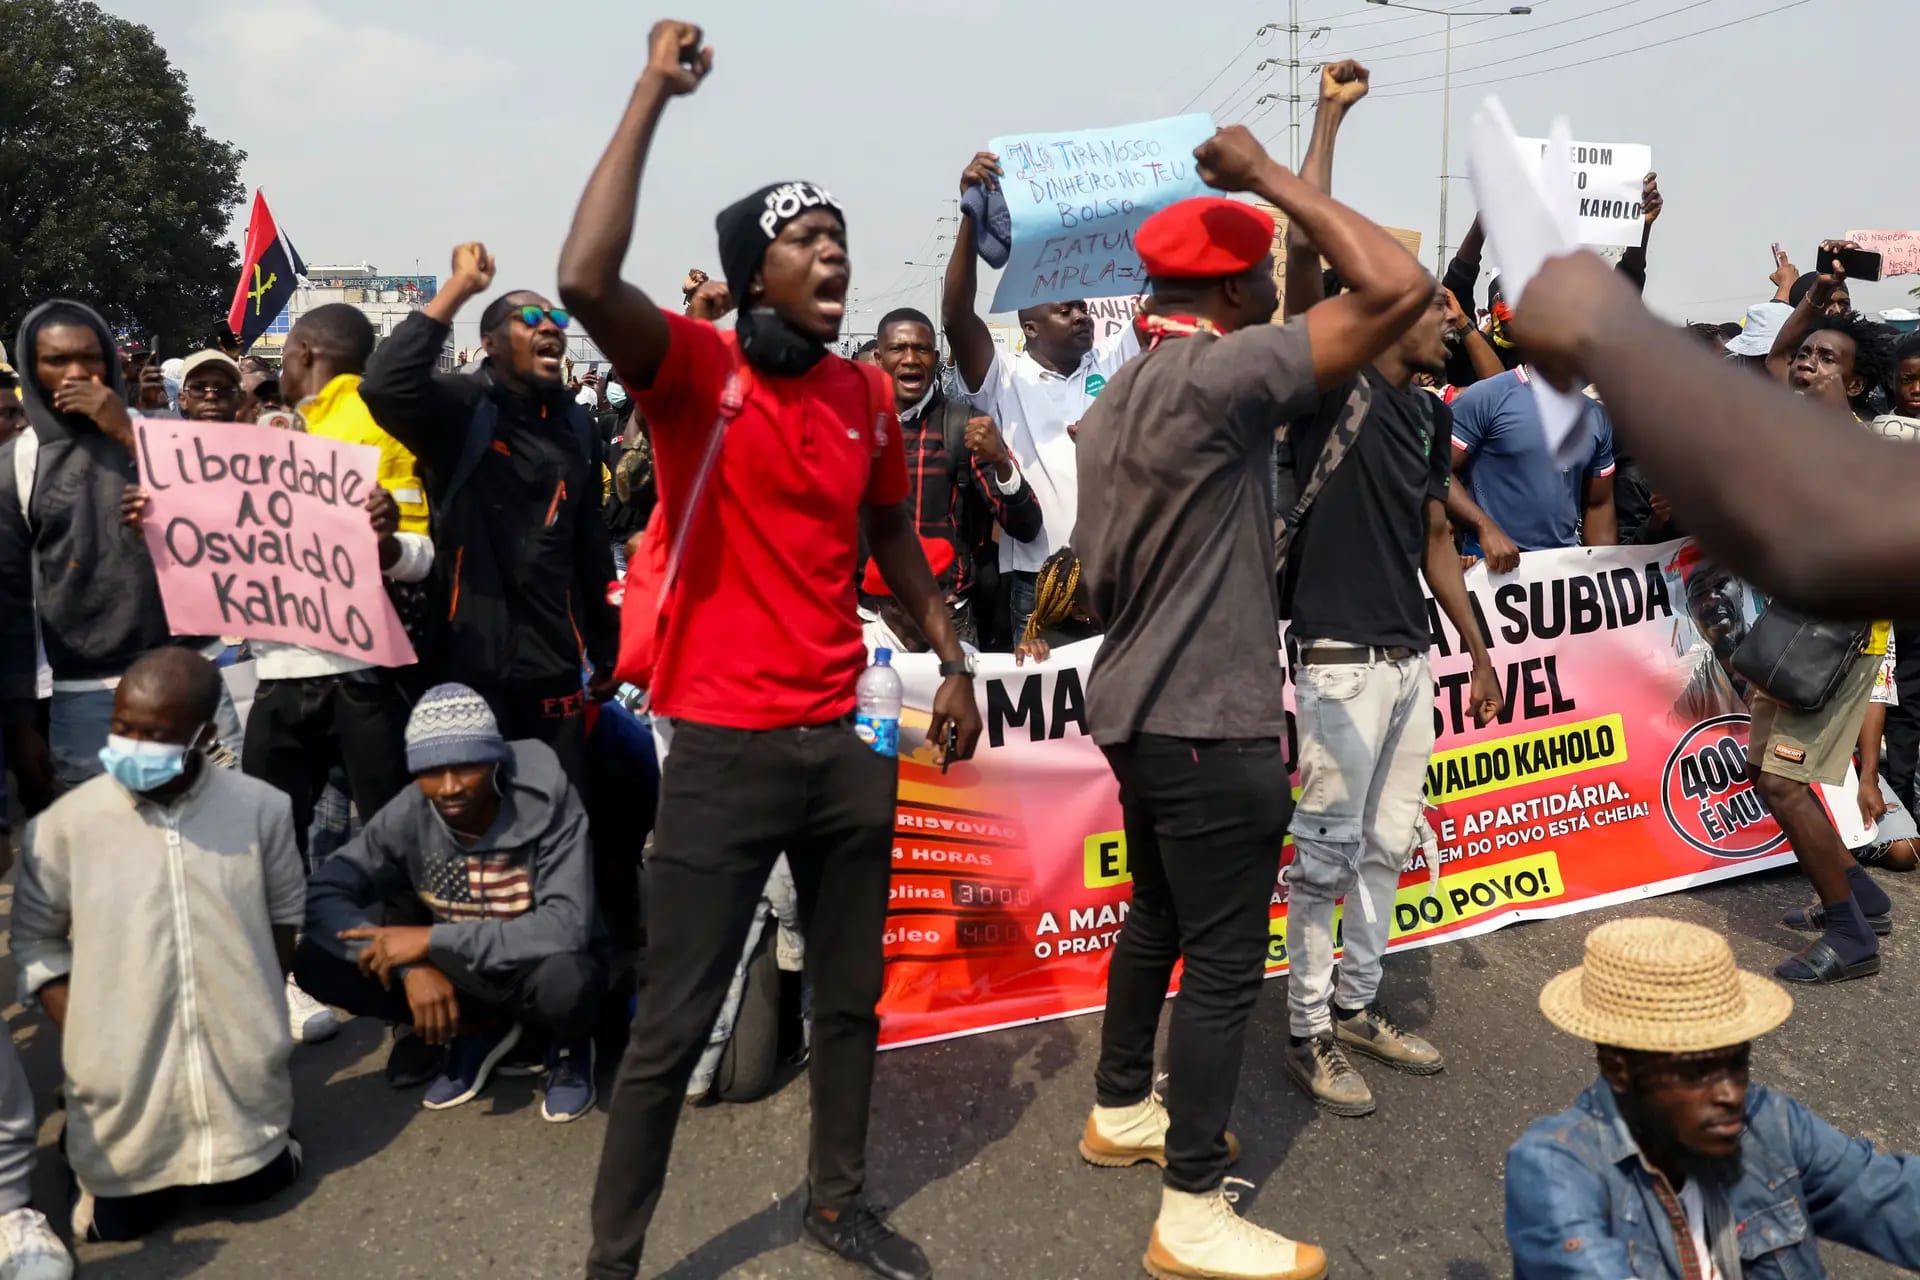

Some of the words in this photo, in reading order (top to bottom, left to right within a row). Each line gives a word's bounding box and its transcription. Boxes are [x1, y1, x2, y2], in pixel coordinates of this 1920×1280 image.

[1101, 140, 1161, 168] NOSSO
[1029, 171, 1117, 203] DINHEIRO
[1118, 169, 1146, 189] NO
[1142, 161, 1185, 188] TEU
[1057, 198, 1135, 228] BOLSO
[1579, 198, 1641, 221] KAHOLO
[236, 490, 293, 528] AO
[165, 517, 355, 589] Osvaldo
[211, 571, 374, 651] Kaholo
[986, 667, 1091, 748] MA
[1495, 561, 1673, 645] SUBIDA
[1423, 747, 1511, 797] VALDO
[1515, 724, 1615, 778] KAHOLO
[1699, 802, 1725, 841] É
[912, 848, 993, 866] HORAS
[1034, 941, 1052, 959] O
[1468, 838, 1492, 858] DO
[1496, 825, 1545, 850] POVO
[1549, 810, 1591, 838] ESTÁ
[1594, 801, 1650, 827] CHEIA!
[1036, 911, 1060, 936] A
[1441, 819, 1457, 842] E
[1463, 780, 1630, 837] APARTIDÁRIA.
[1395, 896, 1444, 931] DO
[1449, 867, 1550, 915] POVO!
